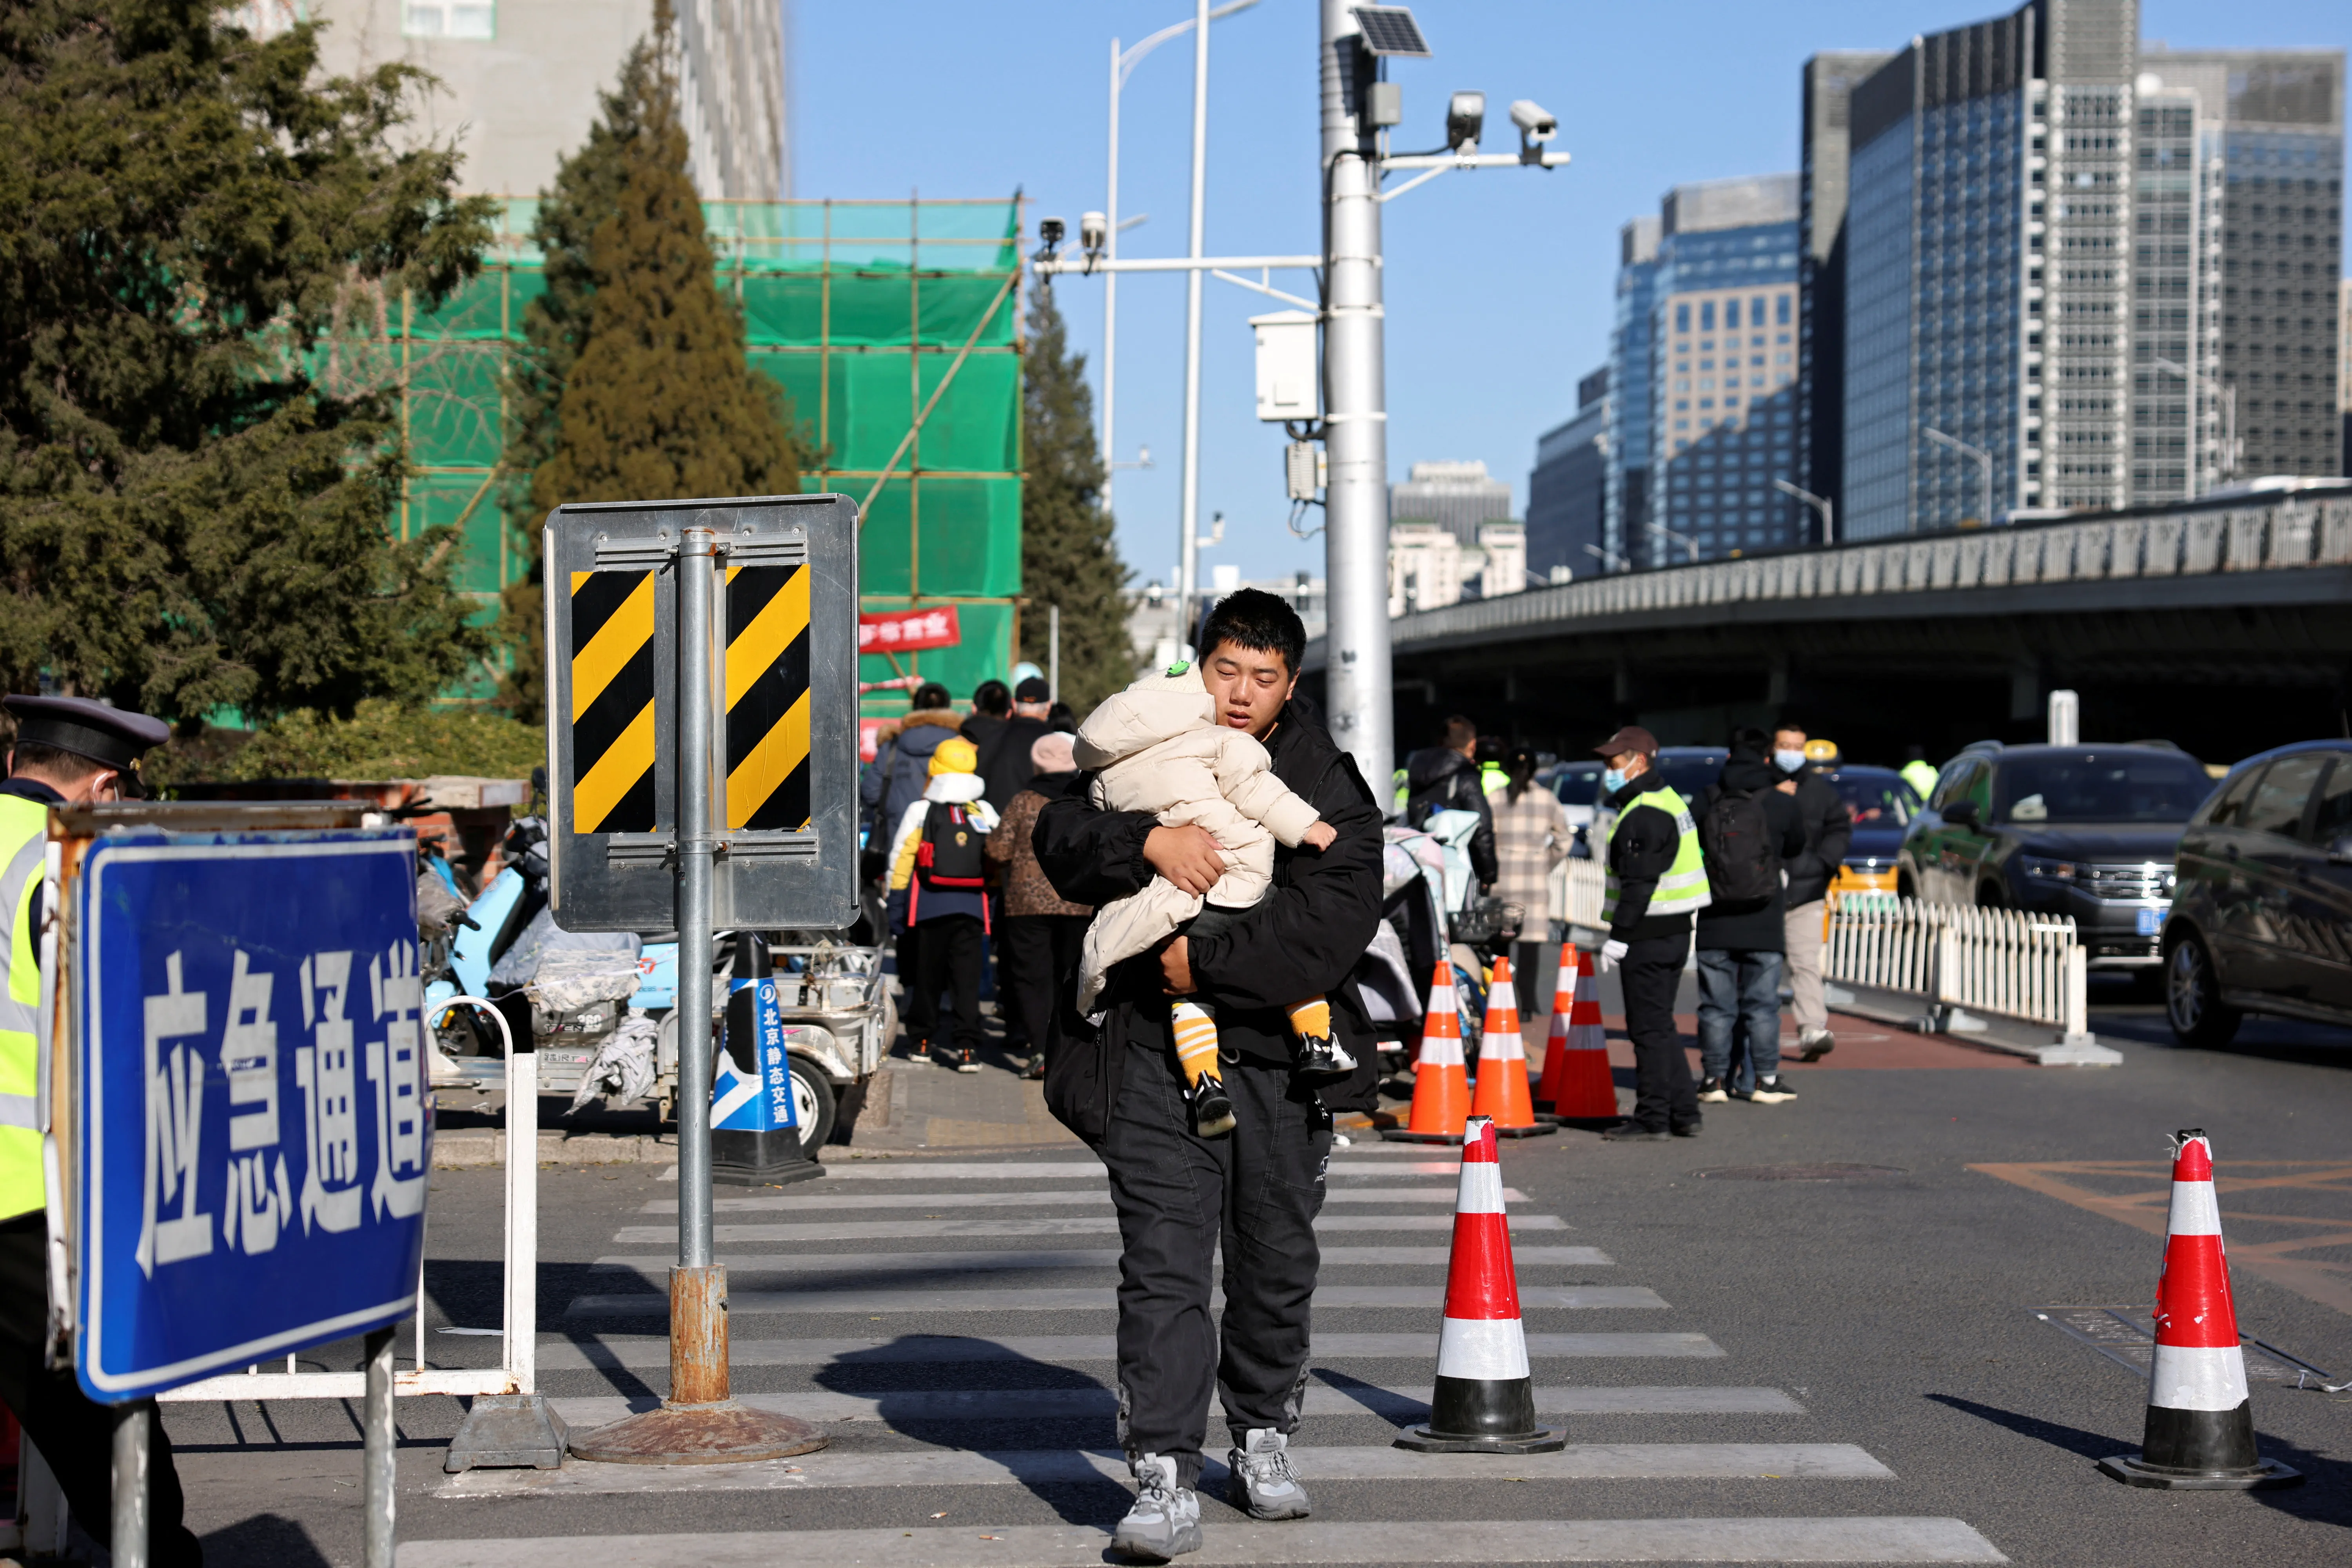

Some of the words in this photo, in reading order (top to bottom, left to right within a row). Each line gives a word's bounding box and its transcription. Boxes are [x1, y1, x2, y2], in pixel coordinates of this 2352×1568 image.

[135, 938, 425, 1280] 应急通道
[763, 1008, 789, 1123] 北京静态交通
